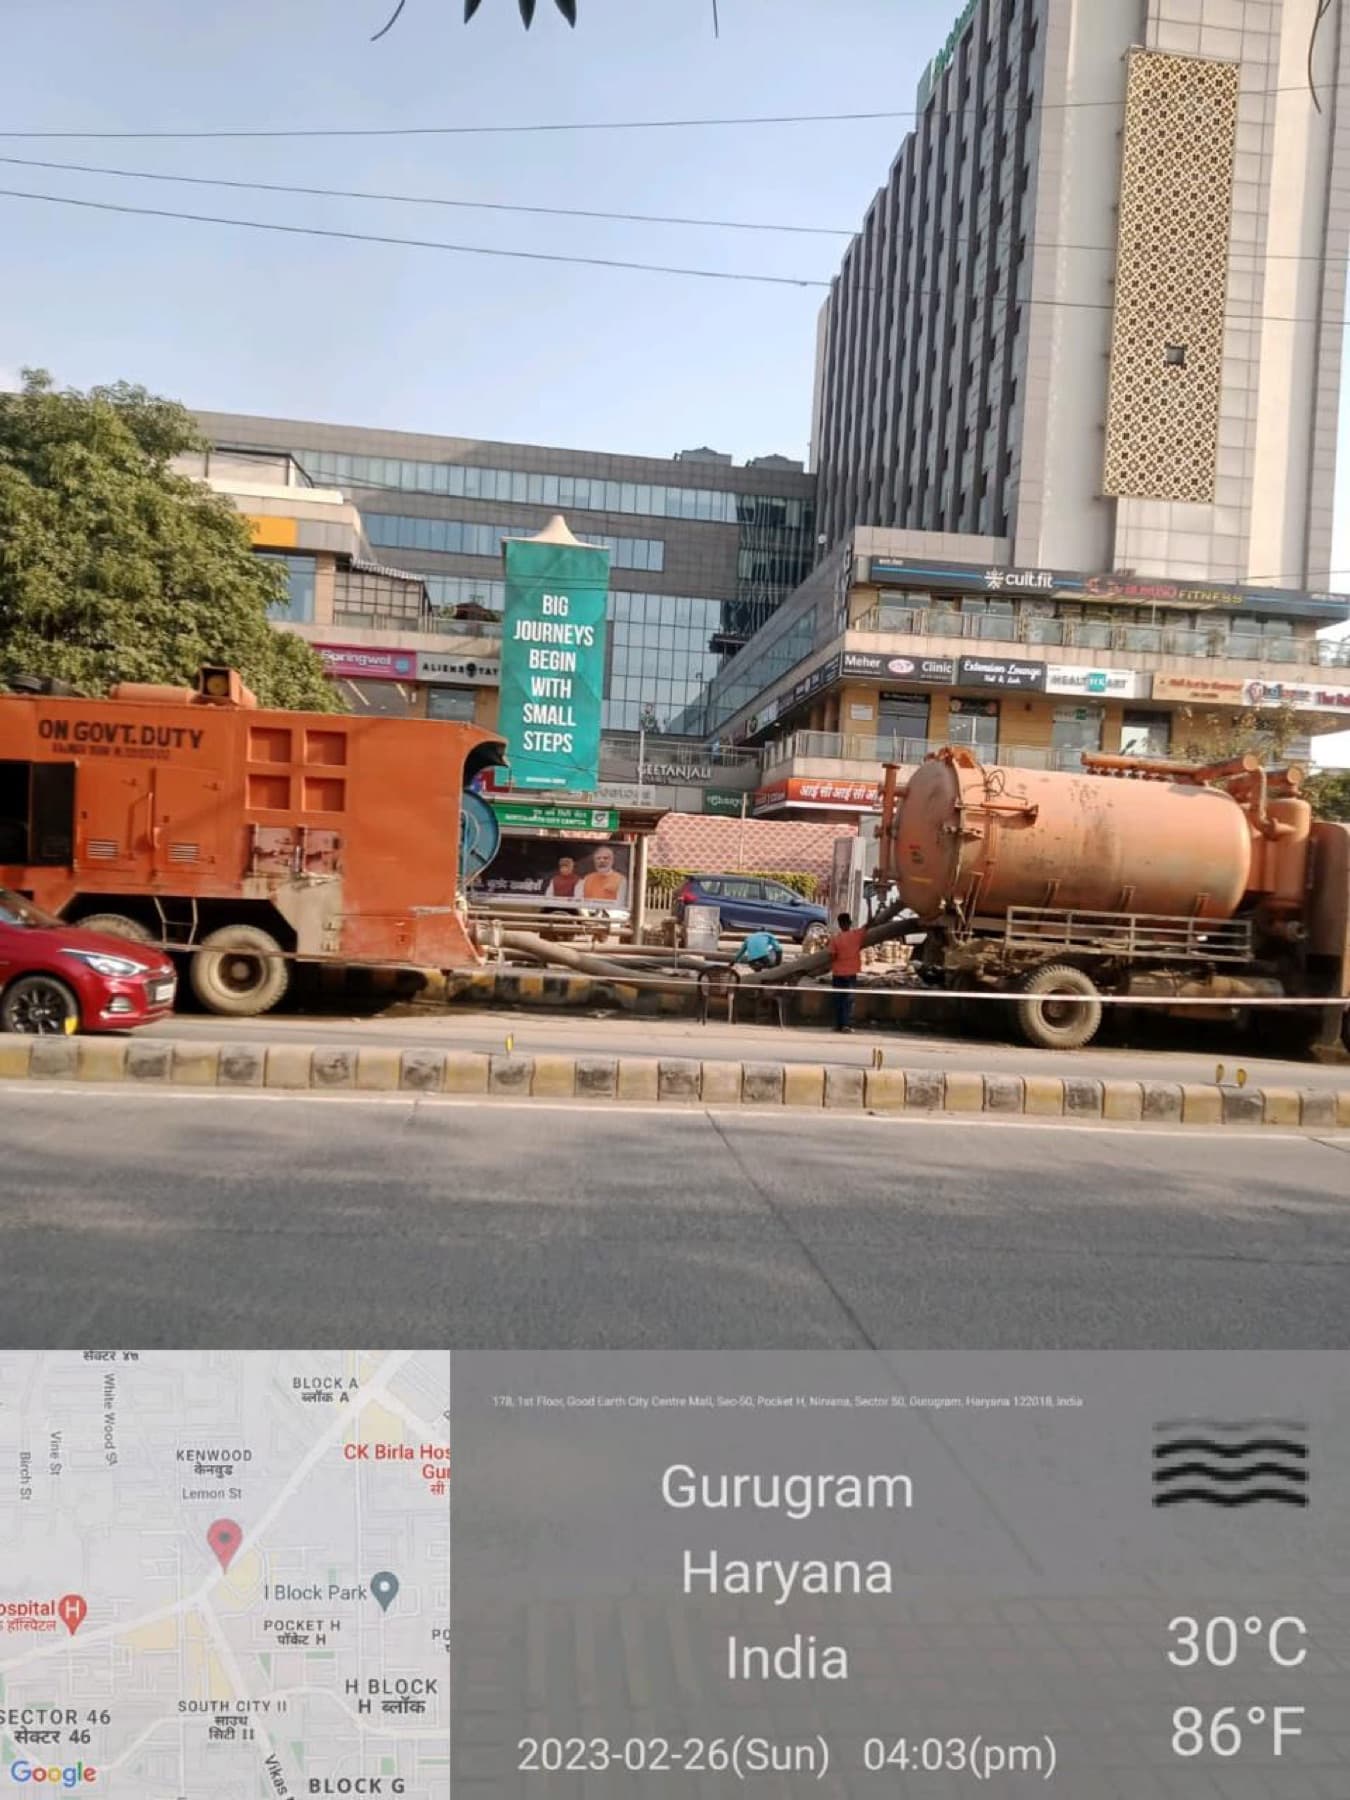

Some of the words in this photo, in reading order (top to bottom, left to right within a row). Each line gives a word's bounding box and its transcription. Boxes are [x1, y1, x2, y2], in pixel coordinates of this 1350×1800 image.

[542, 595, 568, 616] BIG
[513, 620, 594, 646] JOURNEYS
[529, 649, 576, 672] BEGIN
[845, 654, 881, 668] Meher
[922, 661, 953, 673] Clinic
[531, 676, 572, 699] WITH
[523, 703, 576, 726] SMALL
[38, 719, 68, 740] ON
[141, 725, 204, 748] DUTY
[523, 730, 573, 753] STEPS
